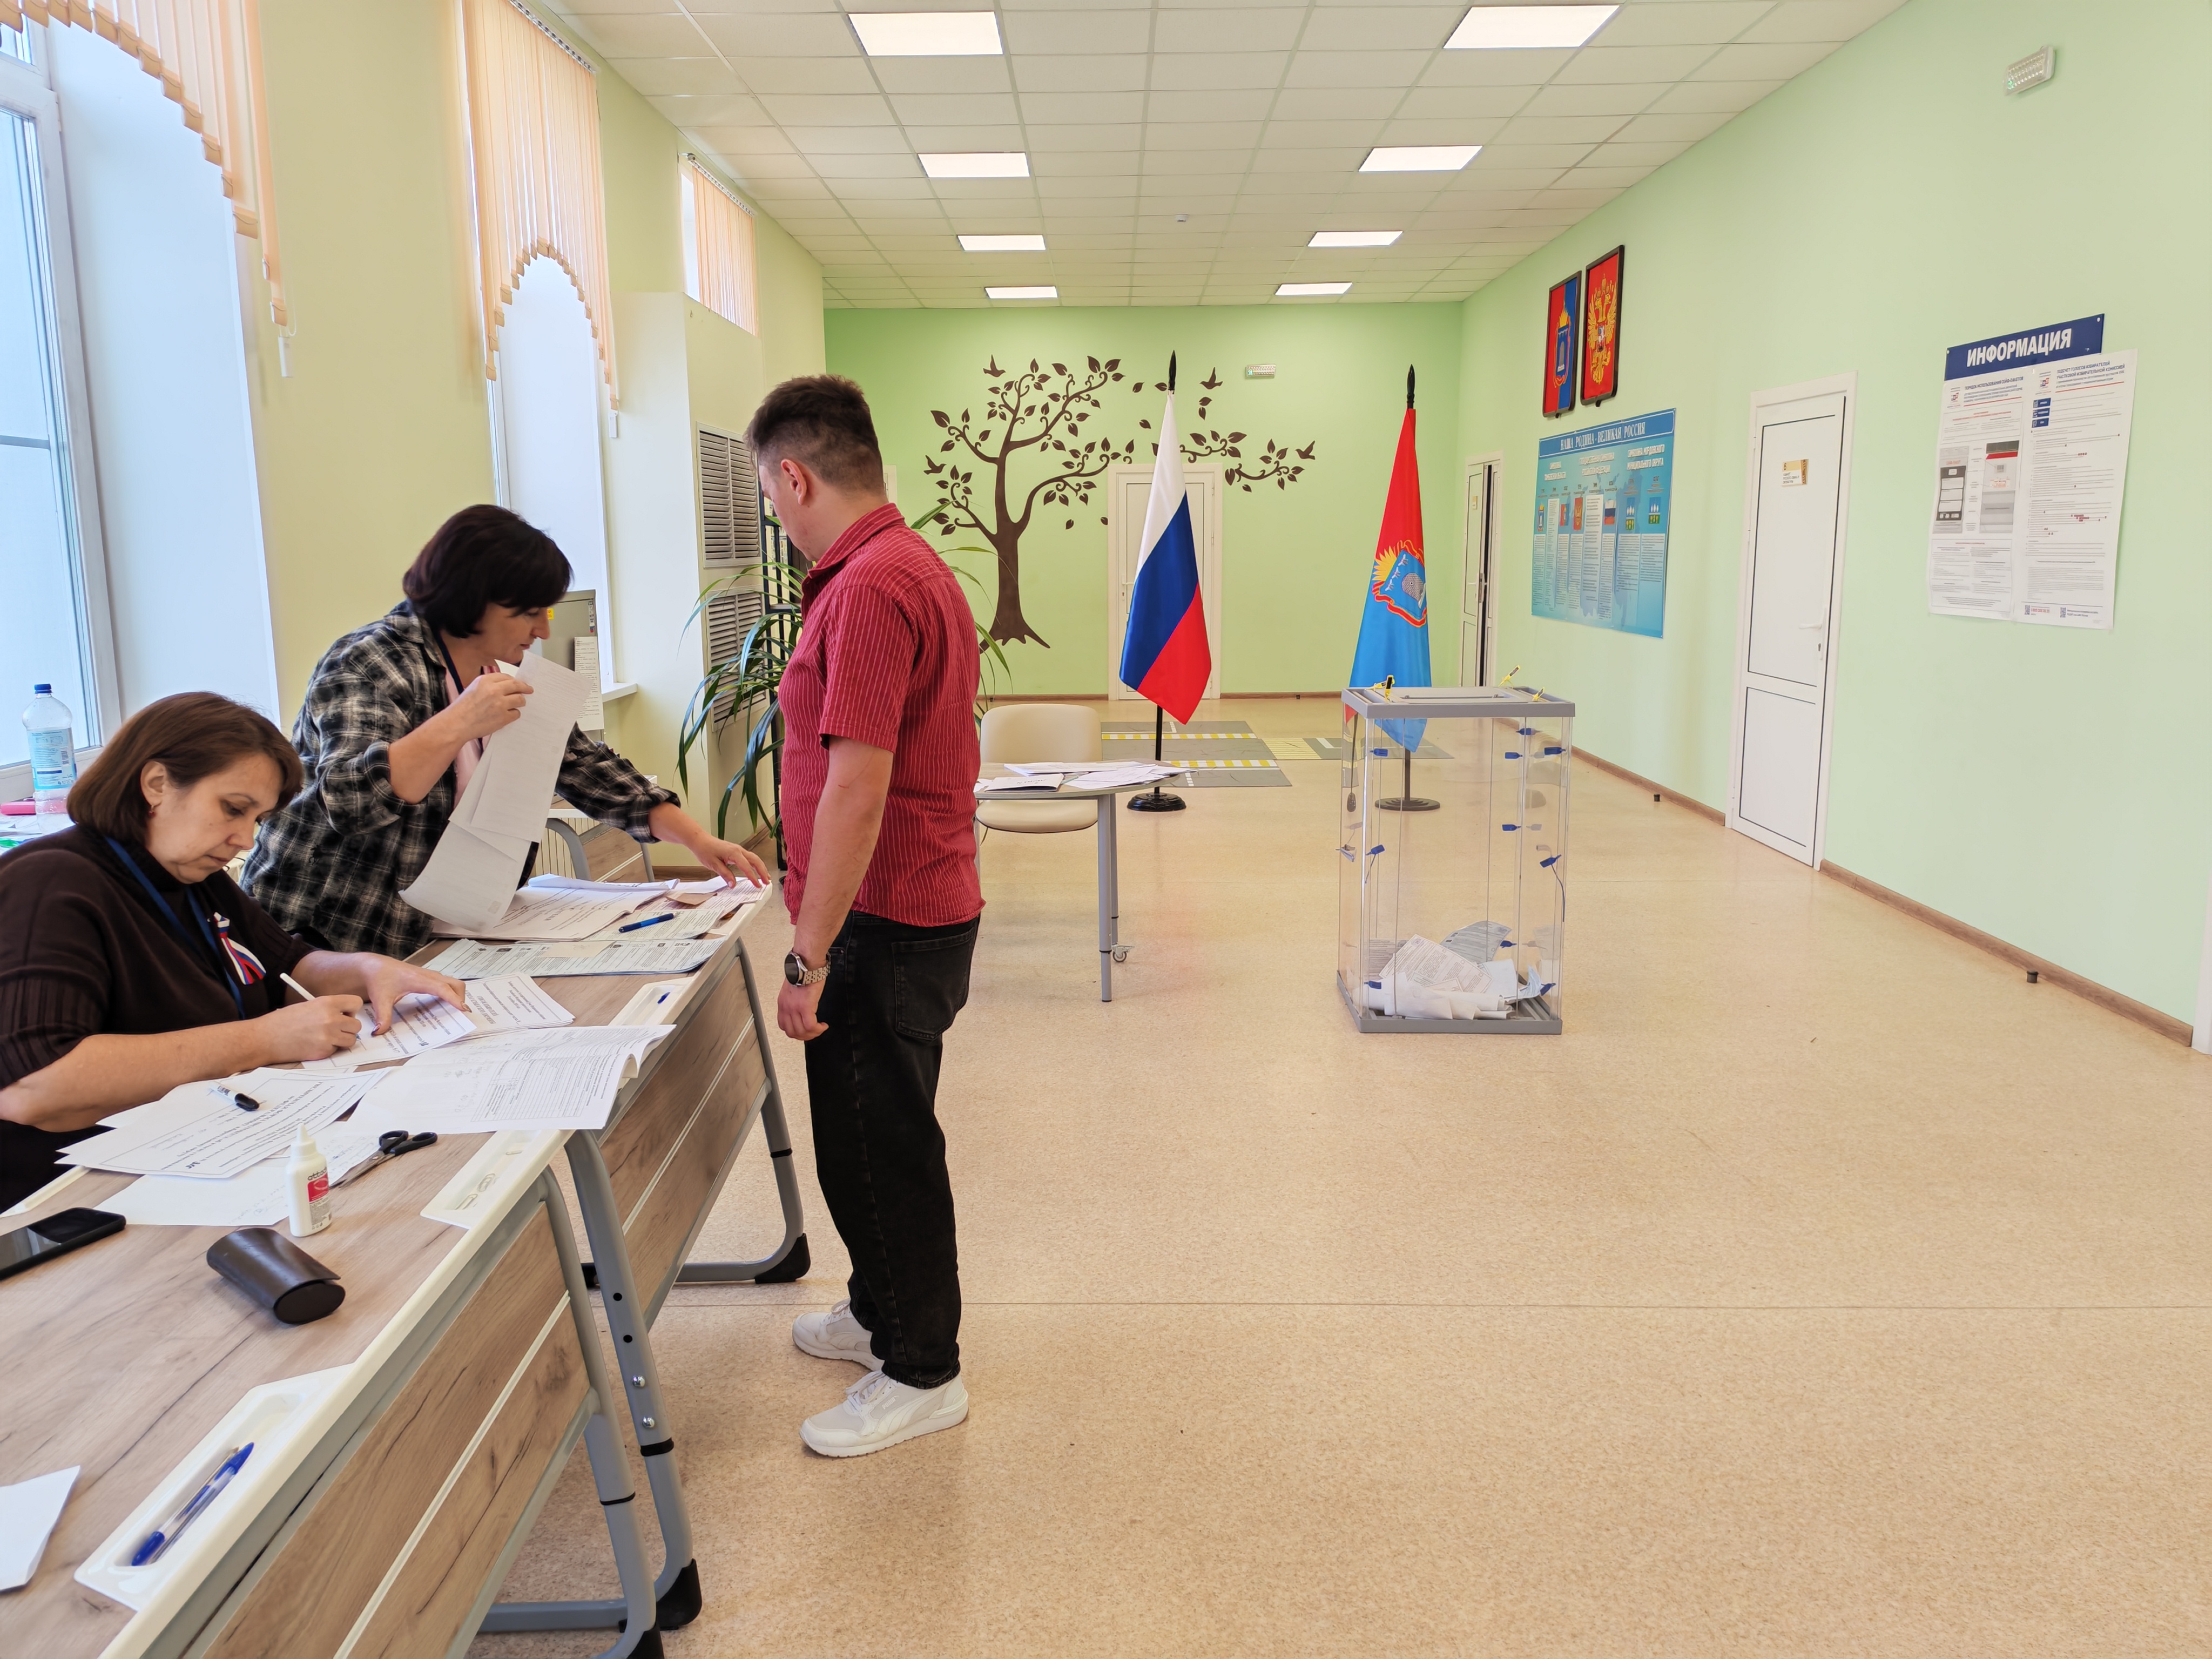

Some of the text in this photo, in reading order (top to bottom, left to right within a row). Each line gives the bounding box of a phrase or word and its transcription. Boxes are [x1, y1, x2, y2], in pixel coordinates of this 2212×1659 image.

[1967, 328, 2072, 367] ИНФОРМАЦИЯ
[2077, 367, 2106, 376] ИЗБИРАТЕЛЬНОЙ
[2106, 363, 2125, 372] КОМИССИЕЙ
[2086, 361, 2110, 369] ИЗБИРАТЕЛЕЙ
[1560, 437, 1574, 450] НАША
[1575, 433, 1594, 448] РОДИНА
[1597, 427, 1622, 443] ВЕЛИКАЯ
[1624, 422, 1645, 438] РОССИЯ
[308, 1167, 327, 1181] attac
